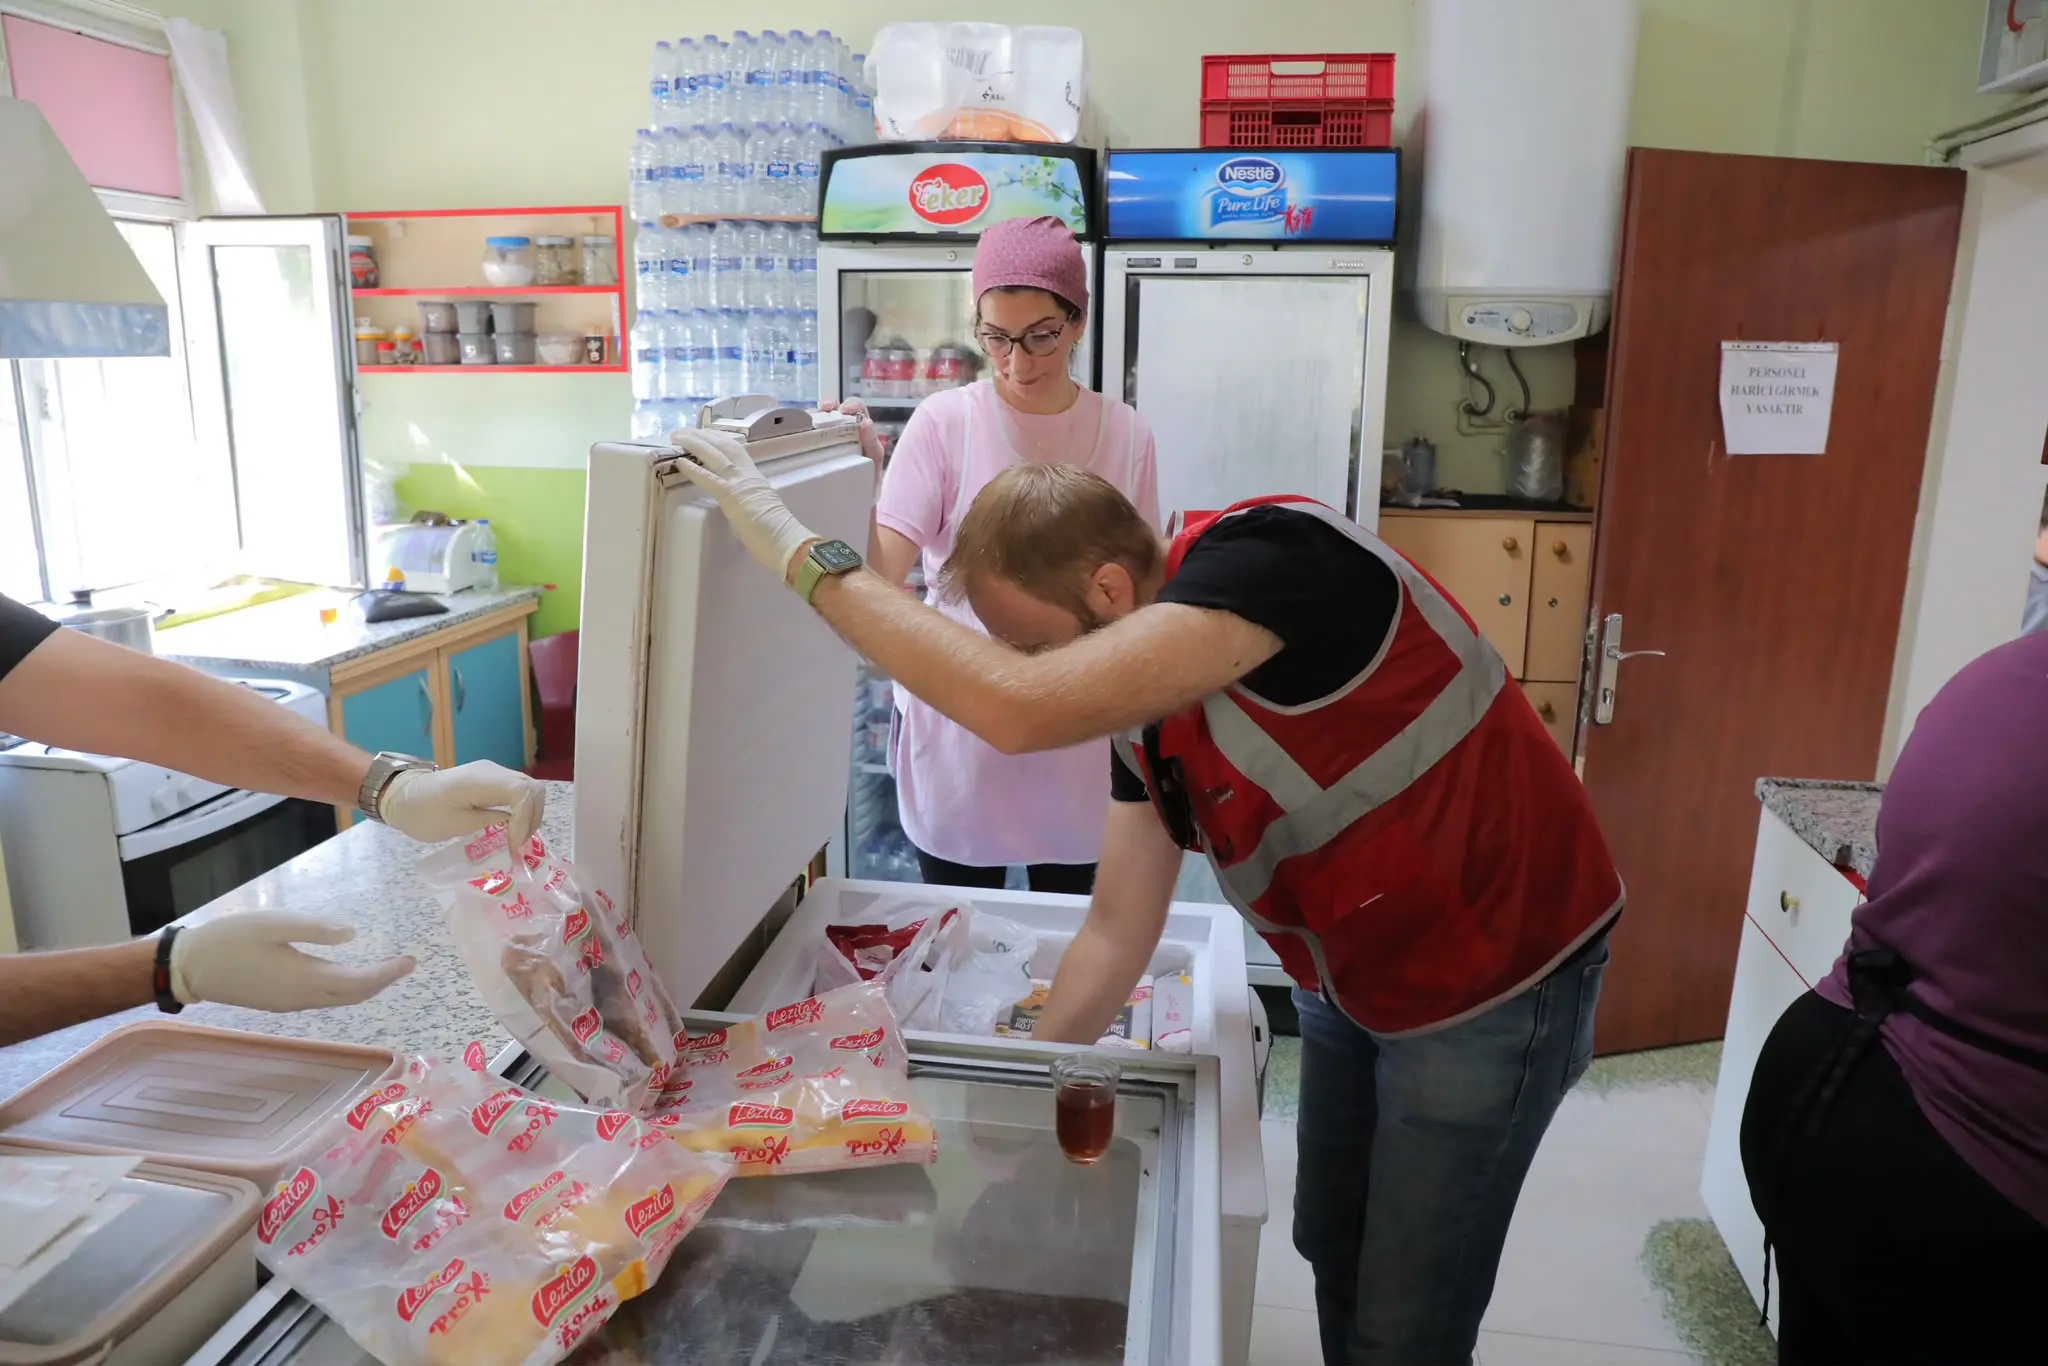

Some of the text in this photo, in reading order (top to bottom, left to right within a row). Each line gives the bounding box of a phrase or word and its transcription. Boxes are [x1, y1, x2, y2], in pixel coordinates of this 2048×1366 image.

[1225, 166, 1275, 180] Nestlé
[925, 181, 985, 213] eker
[1217, 195, 1281, 214] Pure Life
[769, 1001, 811, 1027] Lezita
[688, 1031, 723, 1050] ezita
[835, 1032, 880, 1048] Lezita
[350, 1084, 403, 1126] Lezita
[735, 1101, 788, 1122] Lezita
[847, 1099, 903, 1115] Lezita
[262, 1178, 310, 1238] Lezita
[384, 1178, 437, 1231] Lezita
[510, 1173, 560, 1215] Lezita
[626, 1190, 673, 1234] Lezita
[537, 1265, 592, 1318] Lezita
